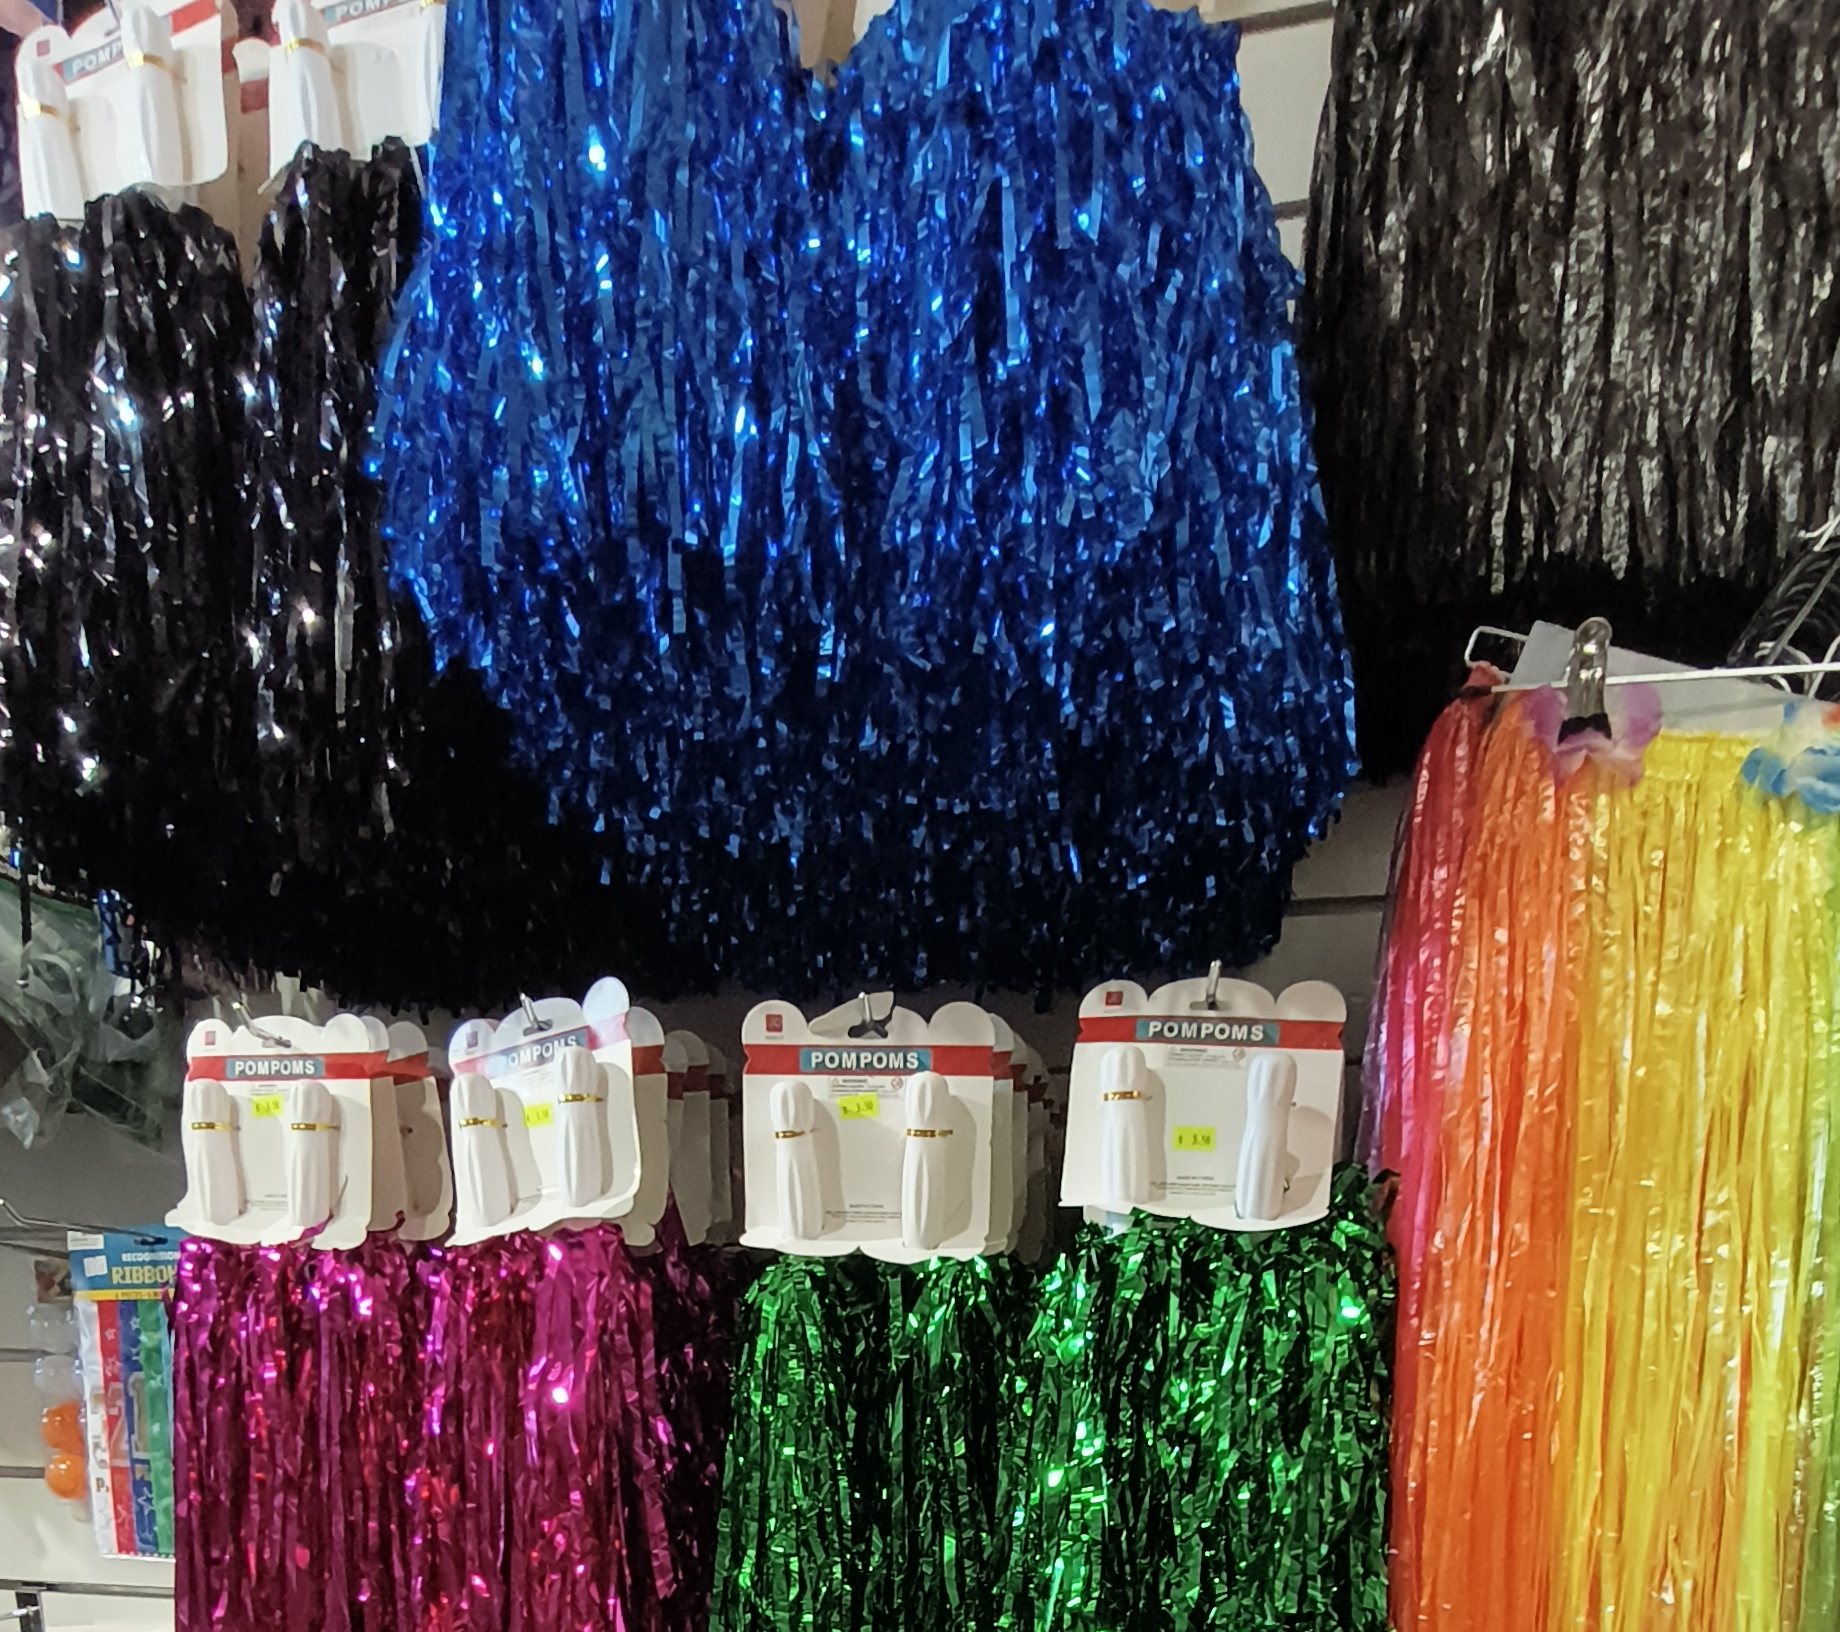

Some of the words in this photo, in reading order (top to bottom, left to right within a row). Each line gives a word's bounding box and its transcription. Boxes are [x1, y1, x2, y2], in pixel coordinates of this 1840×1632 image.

[71, 40, 123, 76] POMP
[1147, 1020, 1265, 1042] POMPOMS
[233, 1060, 316, 1076] POMPOMS
[810, 1051, 919, 1070] POMPOMS
